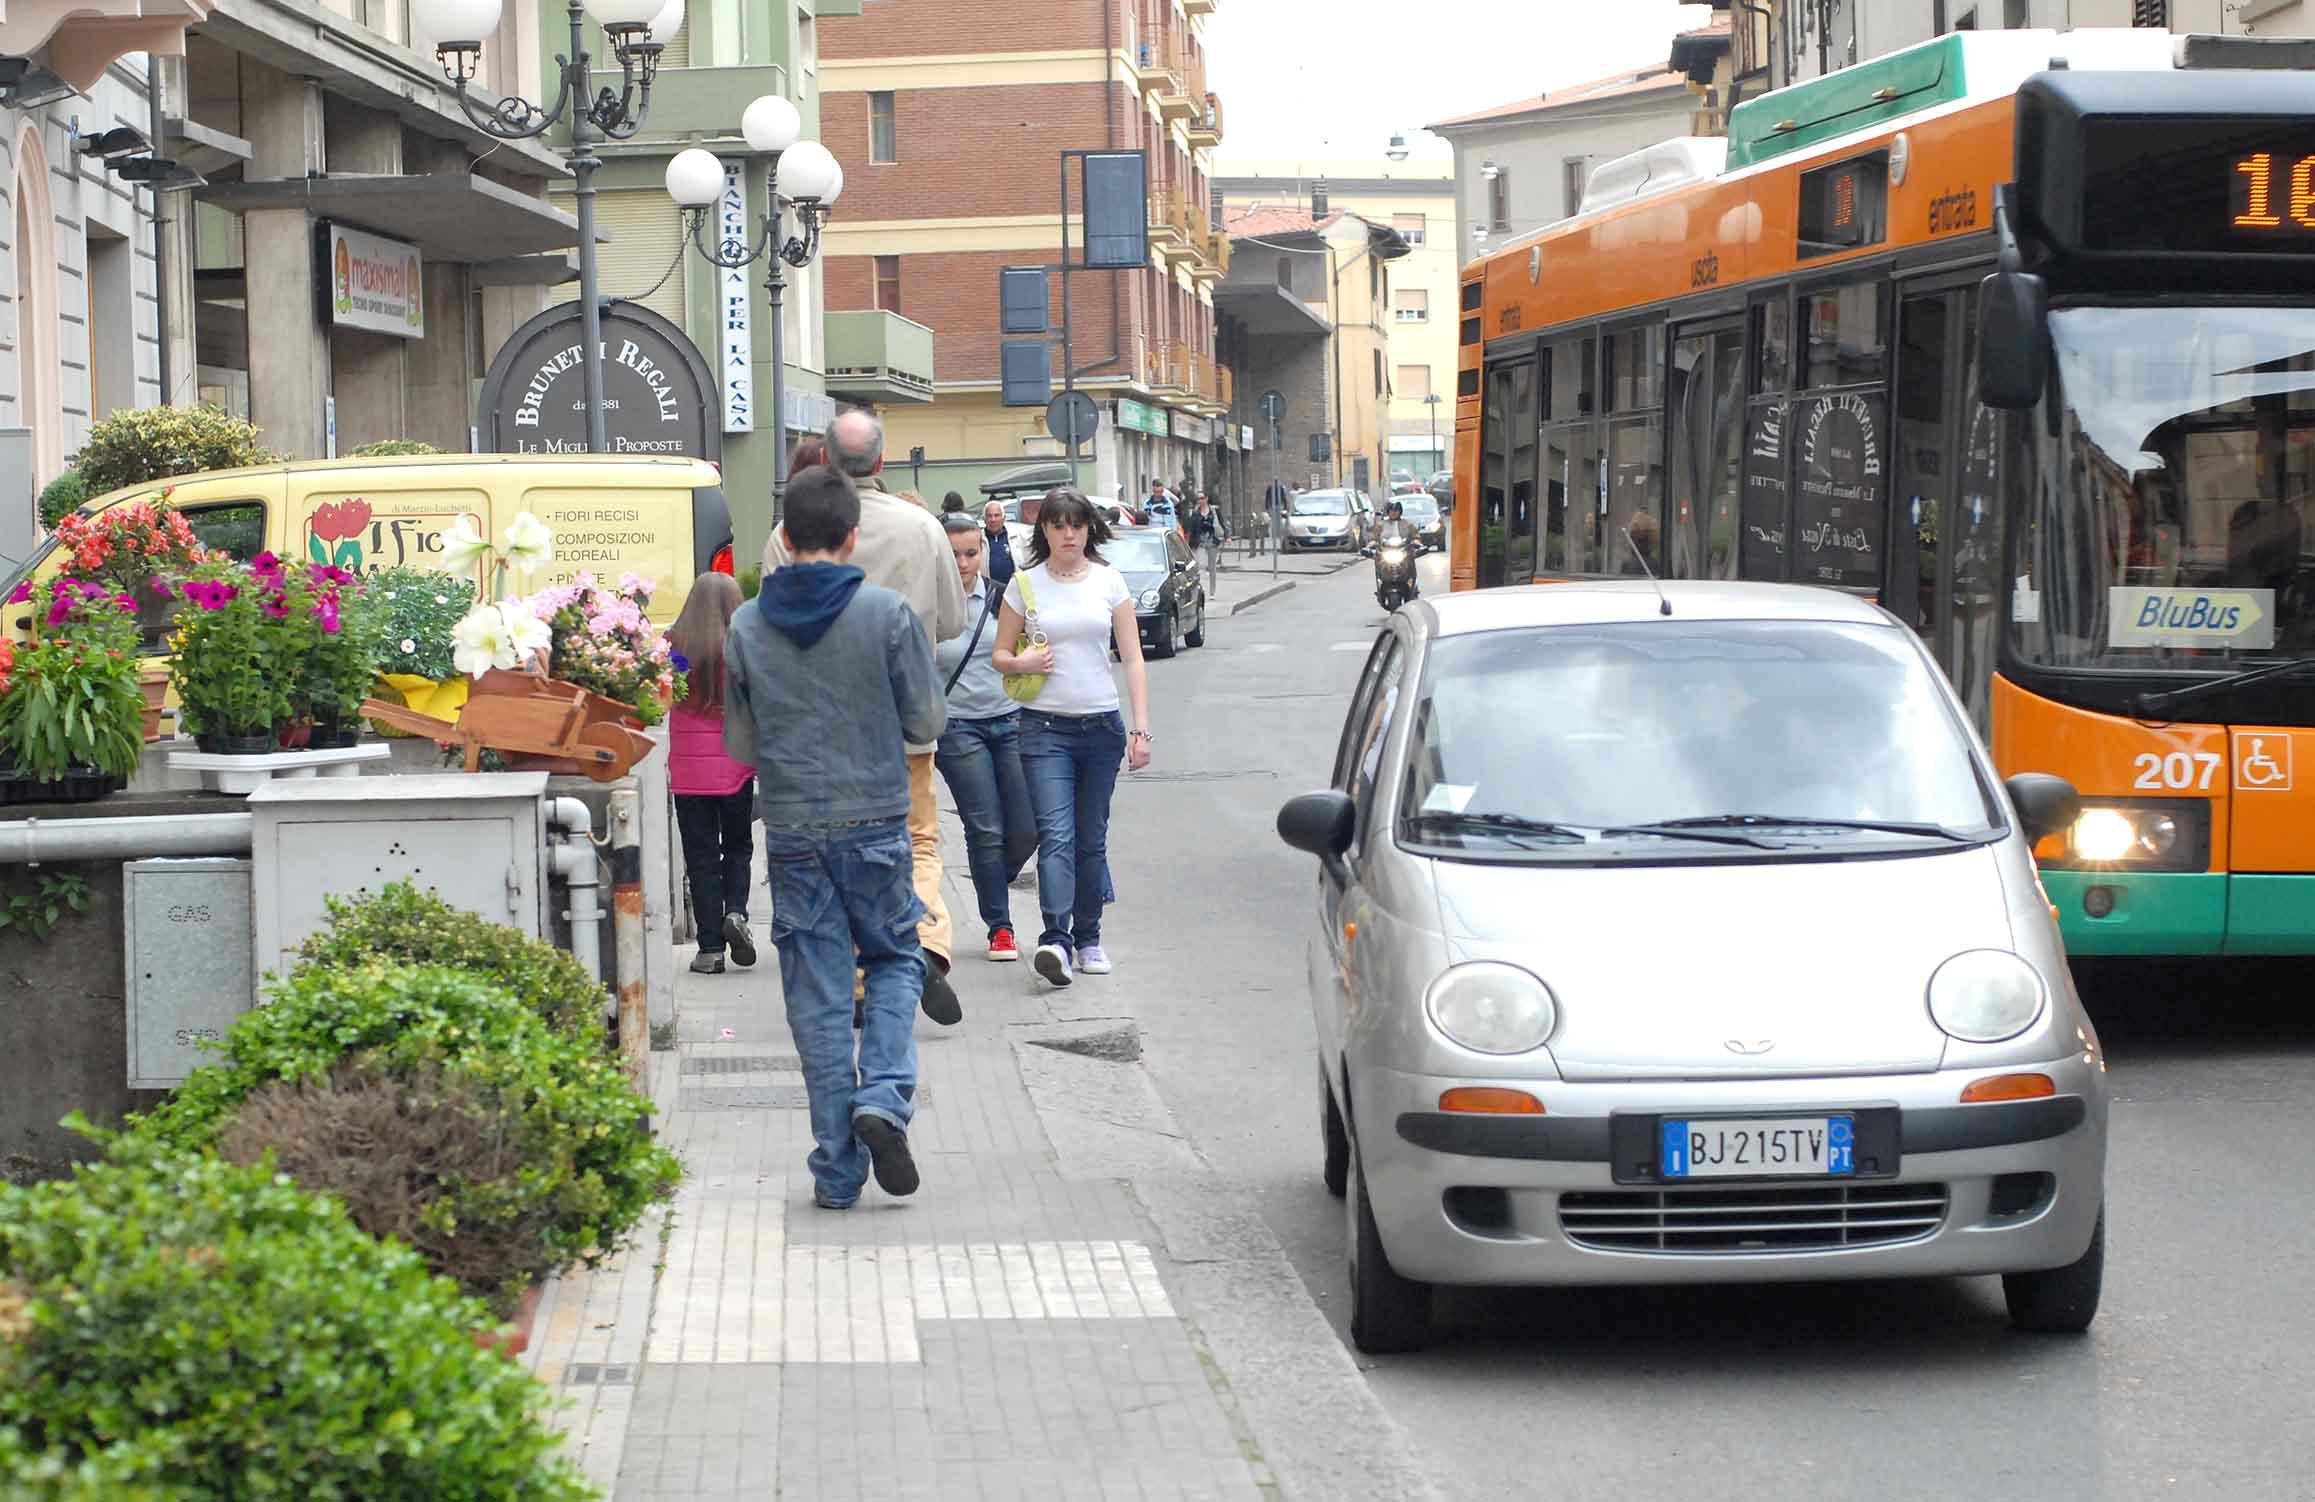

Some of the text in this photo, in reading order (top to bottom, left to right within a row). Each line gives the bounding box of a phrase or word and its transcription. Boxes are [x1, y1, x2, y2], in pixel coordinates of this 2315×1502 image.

[1929, 186, 1976, 235] entrata
[728, 296, 745, 330] PER
[730, 344, 745, 366] LA
[515, 338, 679, 427] BRUNETI REGALI
[730, 380, 747, 426] CASA
[544, 438, 610, 454] MIGLII
[615, 436, 682, 452] PROPOSTE
[554, 510, 639, 521] FIORI RECISI
[556, 533, 655, 545] COMPOSIZIONI
[555, 550, 620, 561] FLOREALI
[2136, 595, 2240, 629] BluBus
[2133, 752, 2221, 790] 207
[168, 904, 212, 923] GAS
[1829, 1147, 1851, 1168] PT
